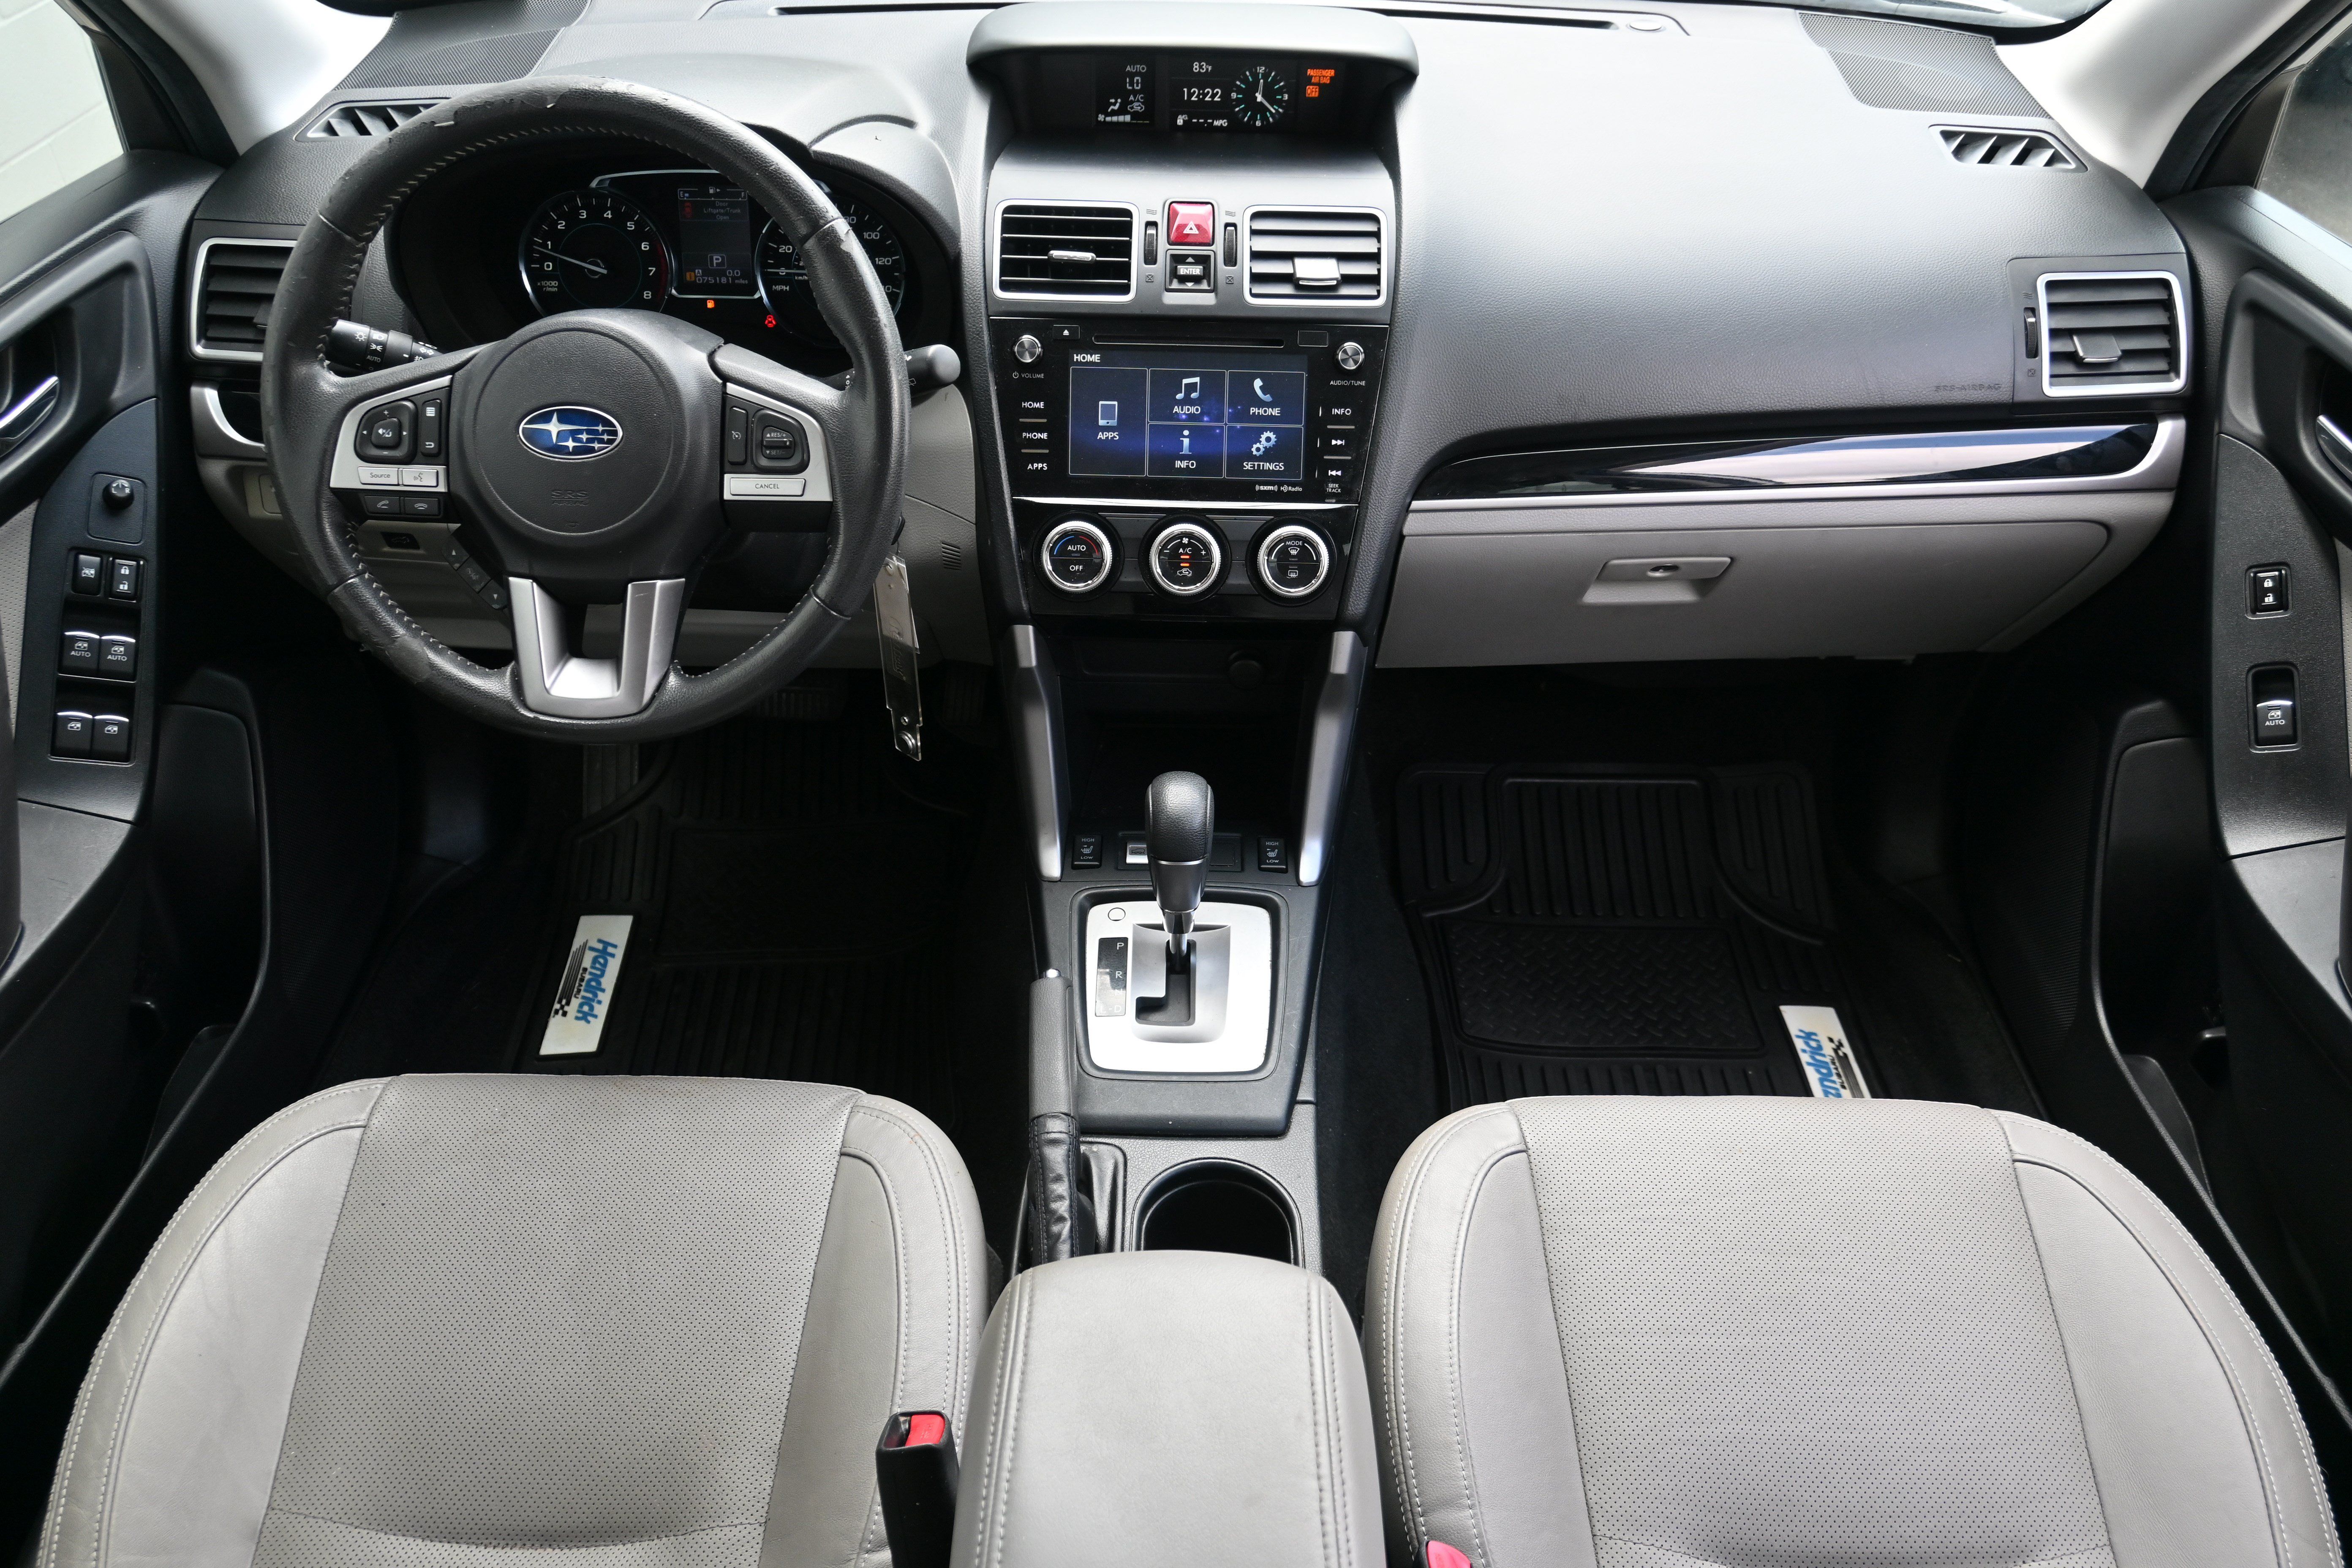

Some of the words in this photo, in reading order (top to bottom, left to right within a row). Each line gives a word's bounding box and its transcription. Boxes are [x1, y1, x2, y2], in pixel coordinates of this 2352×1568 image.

[1183, 88, 1222, 102] 12:22
[1307, 87, 1318, 96] OFF
[1129, 94, 1144, 102] A/C
[1213, 119, 1228, 127] MPG
[579, 210, 587, 218] 3
[604, 210, 612, 218] 4
[557, 221, 566, 229] 2
[626, 222, 634, 230] 5
[547, 241, 552, 249] 1
[641, 242, 650, 250] 6
[779, 245, 792, 253] 20
[713, 256, 722, 267] P
[875, 257, 892, 265] 120
[544, 262, 553, 270] 0
[648, 267, 656, 276] 7
[643, 291, 652, 299] 8
[366, 354, 381, 363] AUTO
[1073, 354, 1100, 363] HOME
[1934, 384, 2001, 392] SRS-AIRBAG
[1022, 401, 1044, 409] HOME
[1173, 406, 1201, 414] AUDIO
[1250, 408, 1280, 416] PHONE
[1332, 408, 1351, 416] INFO
[1022, 432, 1048, 440] PHONE
[1097, 432, 1119, 441] APPS
[1027, 463, 1048, 471] APPS
[1175, 460, 1196, 469] INFO
[1243, 462, 1284, 471] SETTINGS
[551, 489, 588, 499] SRS
[1117, 942, 1124, 950] P
[574, 938, 618, 1024] Hendrick
